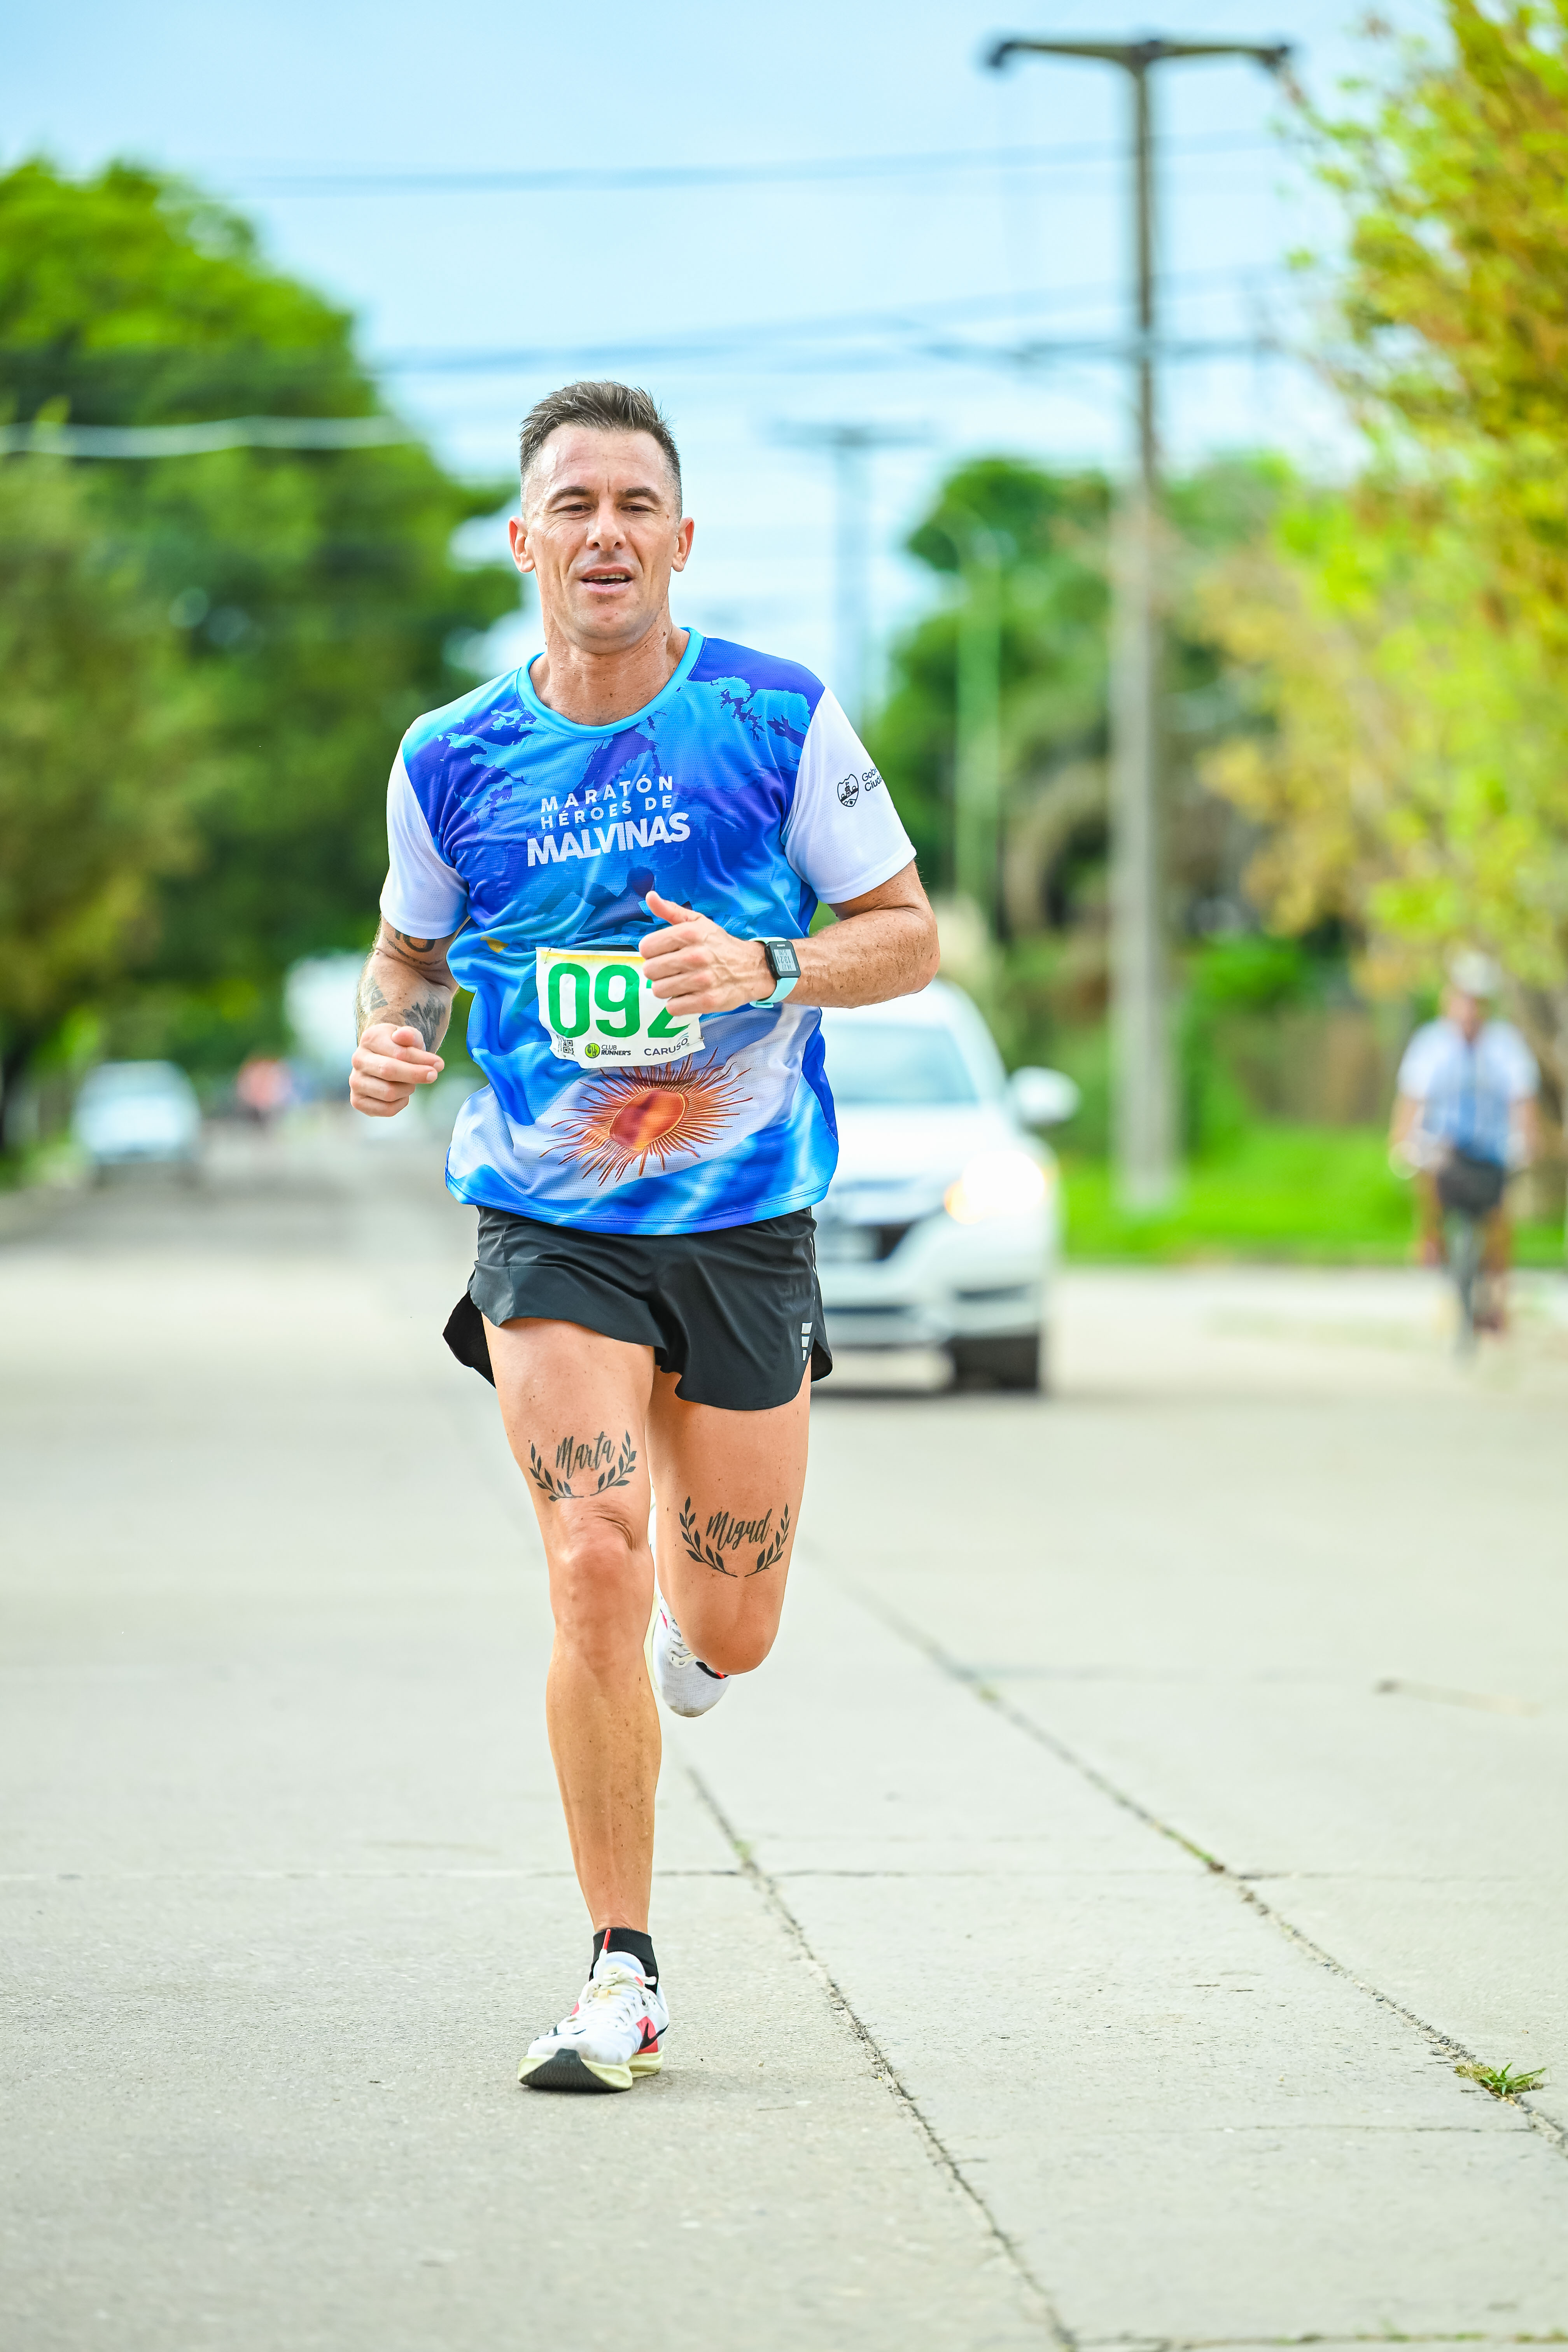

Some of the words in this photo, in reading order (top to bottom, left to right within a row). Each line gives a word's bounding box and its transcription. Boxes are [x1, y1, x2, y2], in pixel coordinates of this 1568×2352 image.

[540, 774, 672, 813] MARATÓN
[541, 800, 632, 830] HÉROES
[645, 795, 672, 811] DE
[527, 812, 690, 867] MALVINAS
[644, 1038, 688, 1056] CARUSO
[556, 1431, 616, 1479] Marta
[706, 1508, 773, 1551] Miguel
